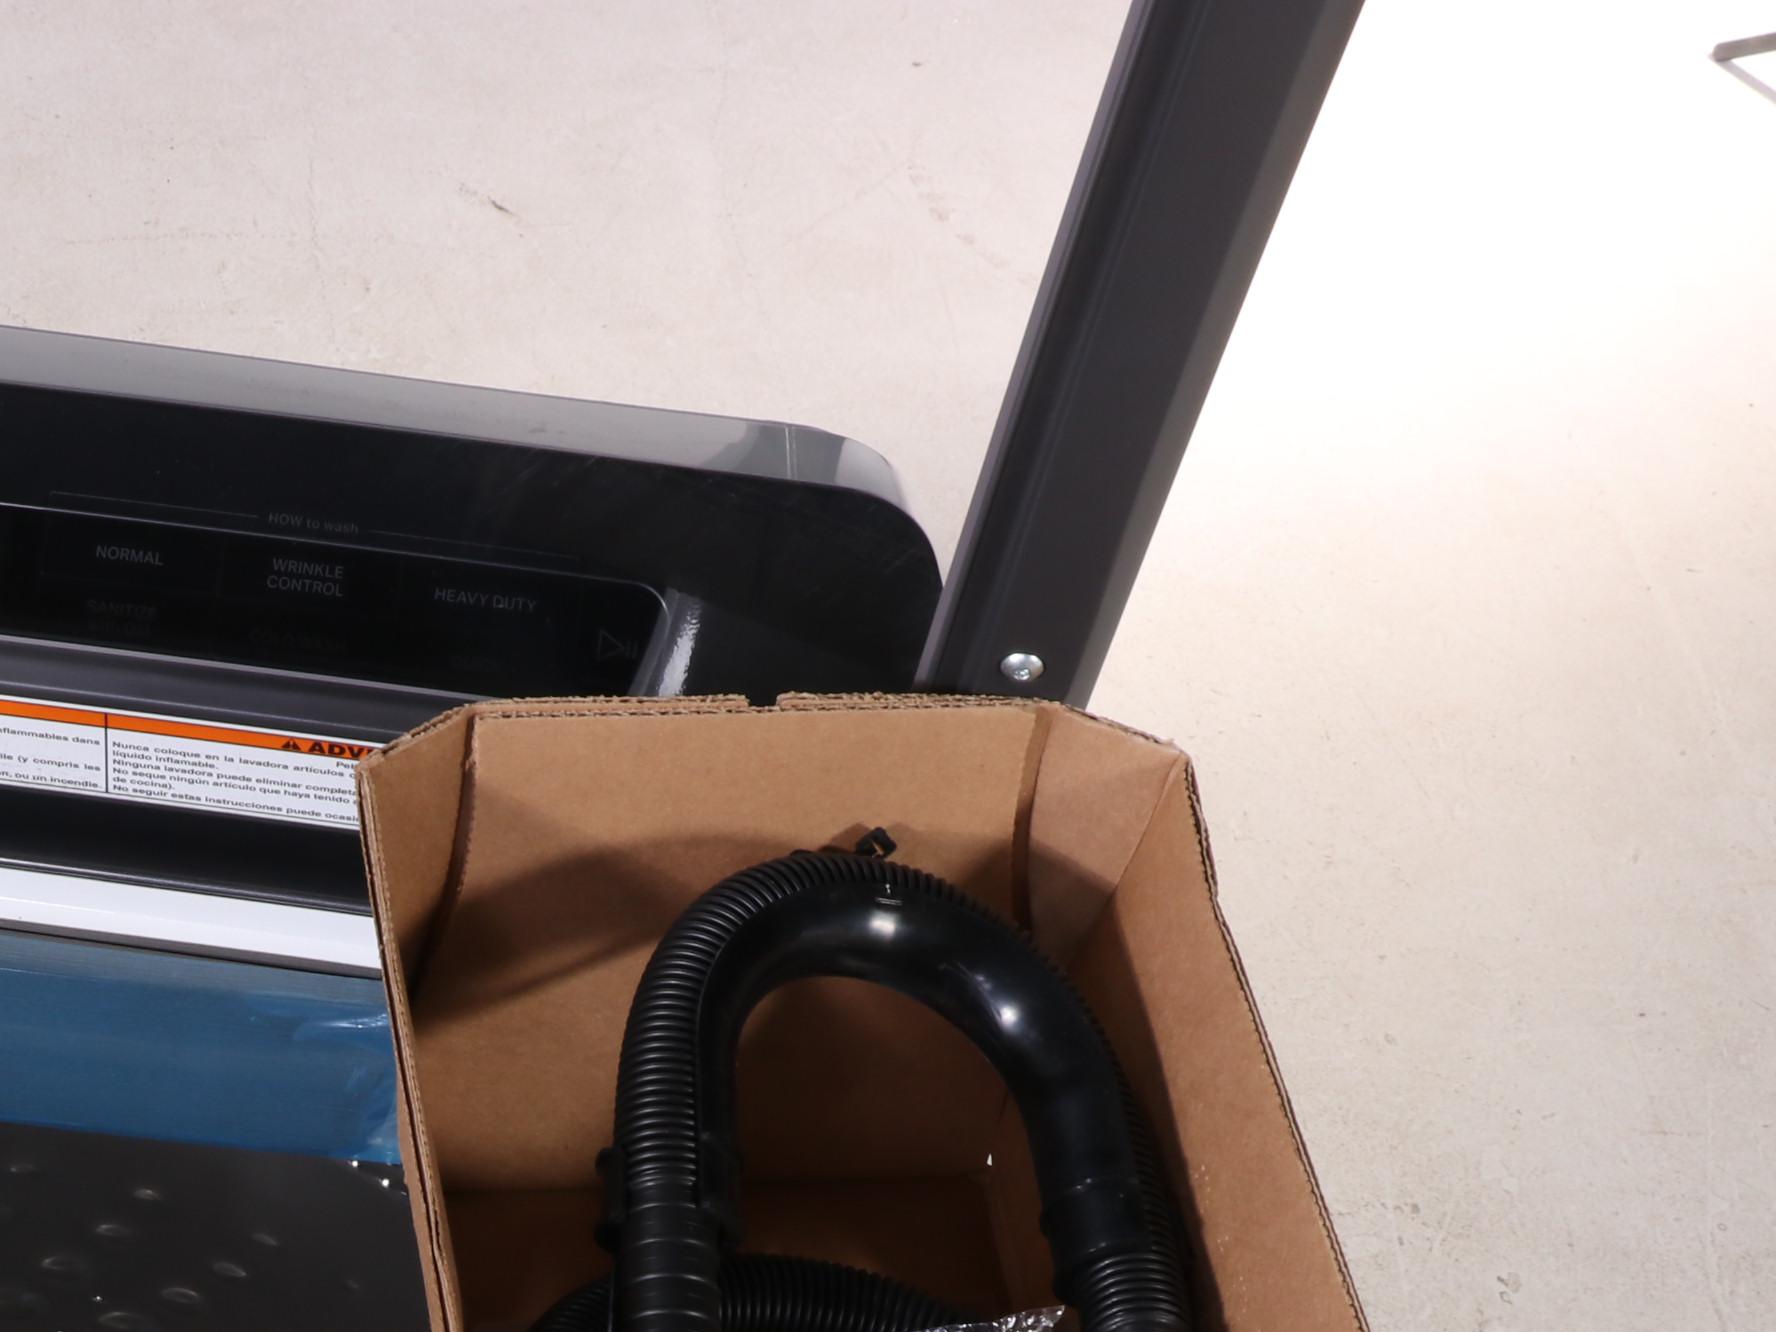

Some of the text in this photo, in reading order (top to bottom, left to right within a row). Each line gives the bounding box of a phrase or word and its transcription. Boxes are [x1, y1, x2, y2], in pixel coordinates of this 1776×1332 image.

[268, 512, 359, 534] HOW to wash
[95, 545, 164, 566] NORMAL
[272, 557, 344, 580] WRINKLE
[266, 575, 344, 597] CONTROL
[433, 587, 536, 613] HEAVY DUTY
[71, 734, 100, 744] dans
[112, 741, 149, 752] Nunca
[153, 746, 200, 761] coloque
[239, 757, 288, 770] lavadora
[155, 755, 218, 769] inflamable.
[112, 758, 161, 773] Ninguna
[164, 765, 213, 777] lavadora
[216, 771, 252, 784] puede
[255, 776, 302, 789] eliminar
[130, 777, 175, 791] cocina).
[132, 770, 166, 782] seque
[259, 786, 280, 796] que
[283, 788, 310, 800] haya
[313, 792, 349, 803] tenido
[131, 786, 167, 799] seguir
[170, 791, 201, 801] estas
[204, 795, 282, 811] instrucciones
[286, 805, 321, 817] puede
